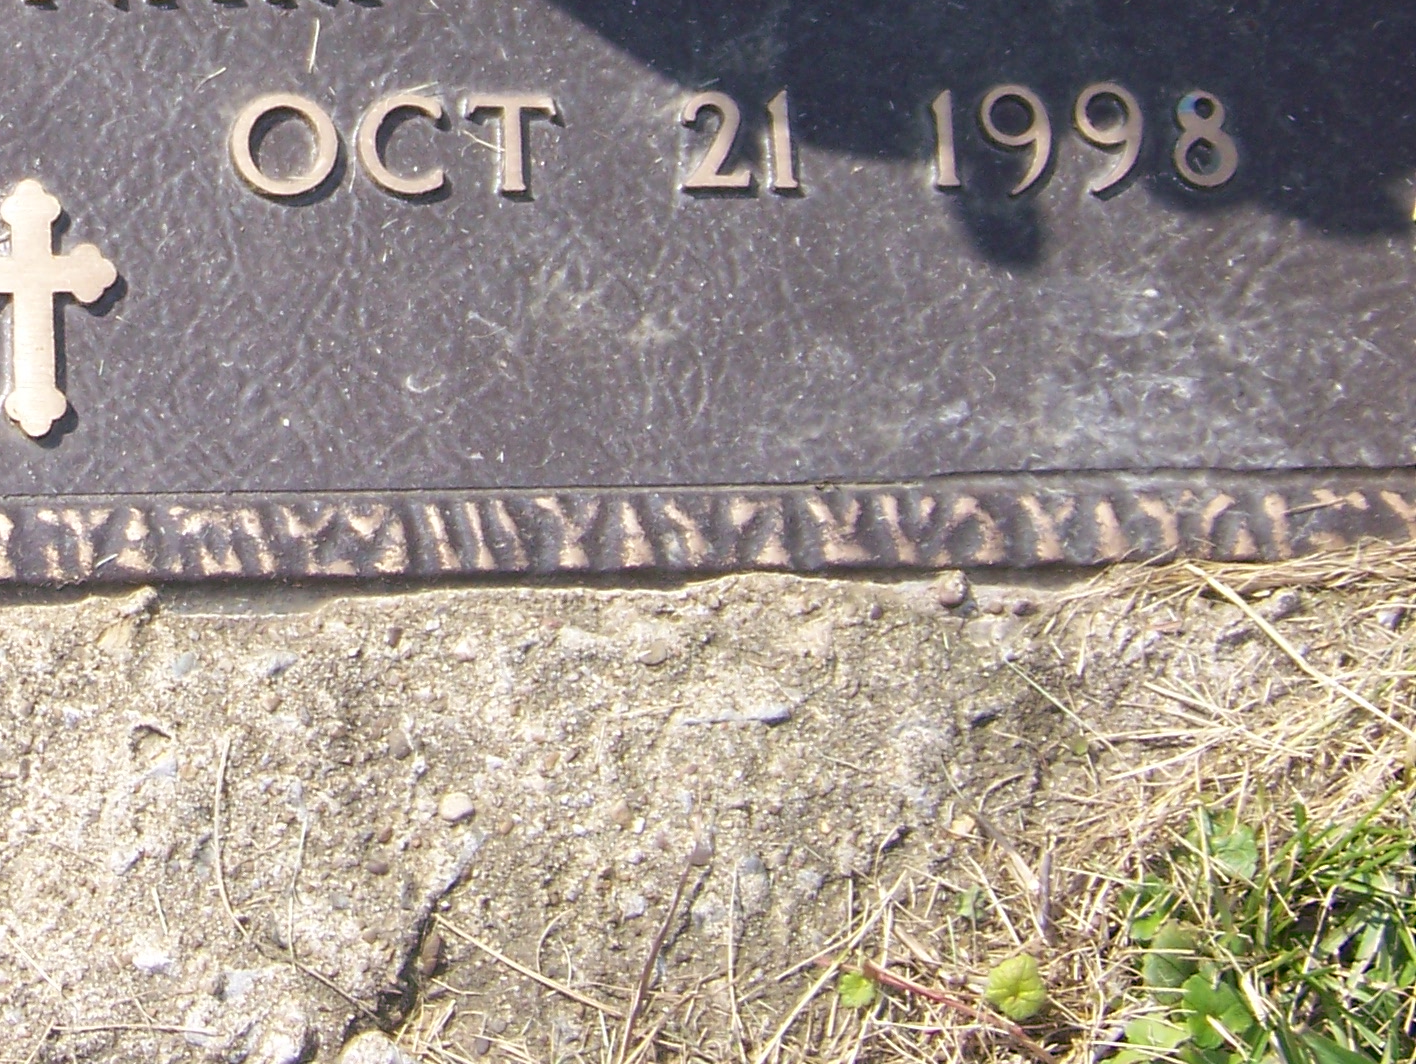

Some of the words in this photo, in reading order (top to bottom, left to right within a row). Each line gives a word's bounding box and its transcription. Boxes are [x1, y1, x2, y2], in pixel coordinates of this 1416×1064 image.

[228, 93, 558, 199] OCT
[679, 90, 803, 195] 21
[930, 82, 1240, 198] 1998
